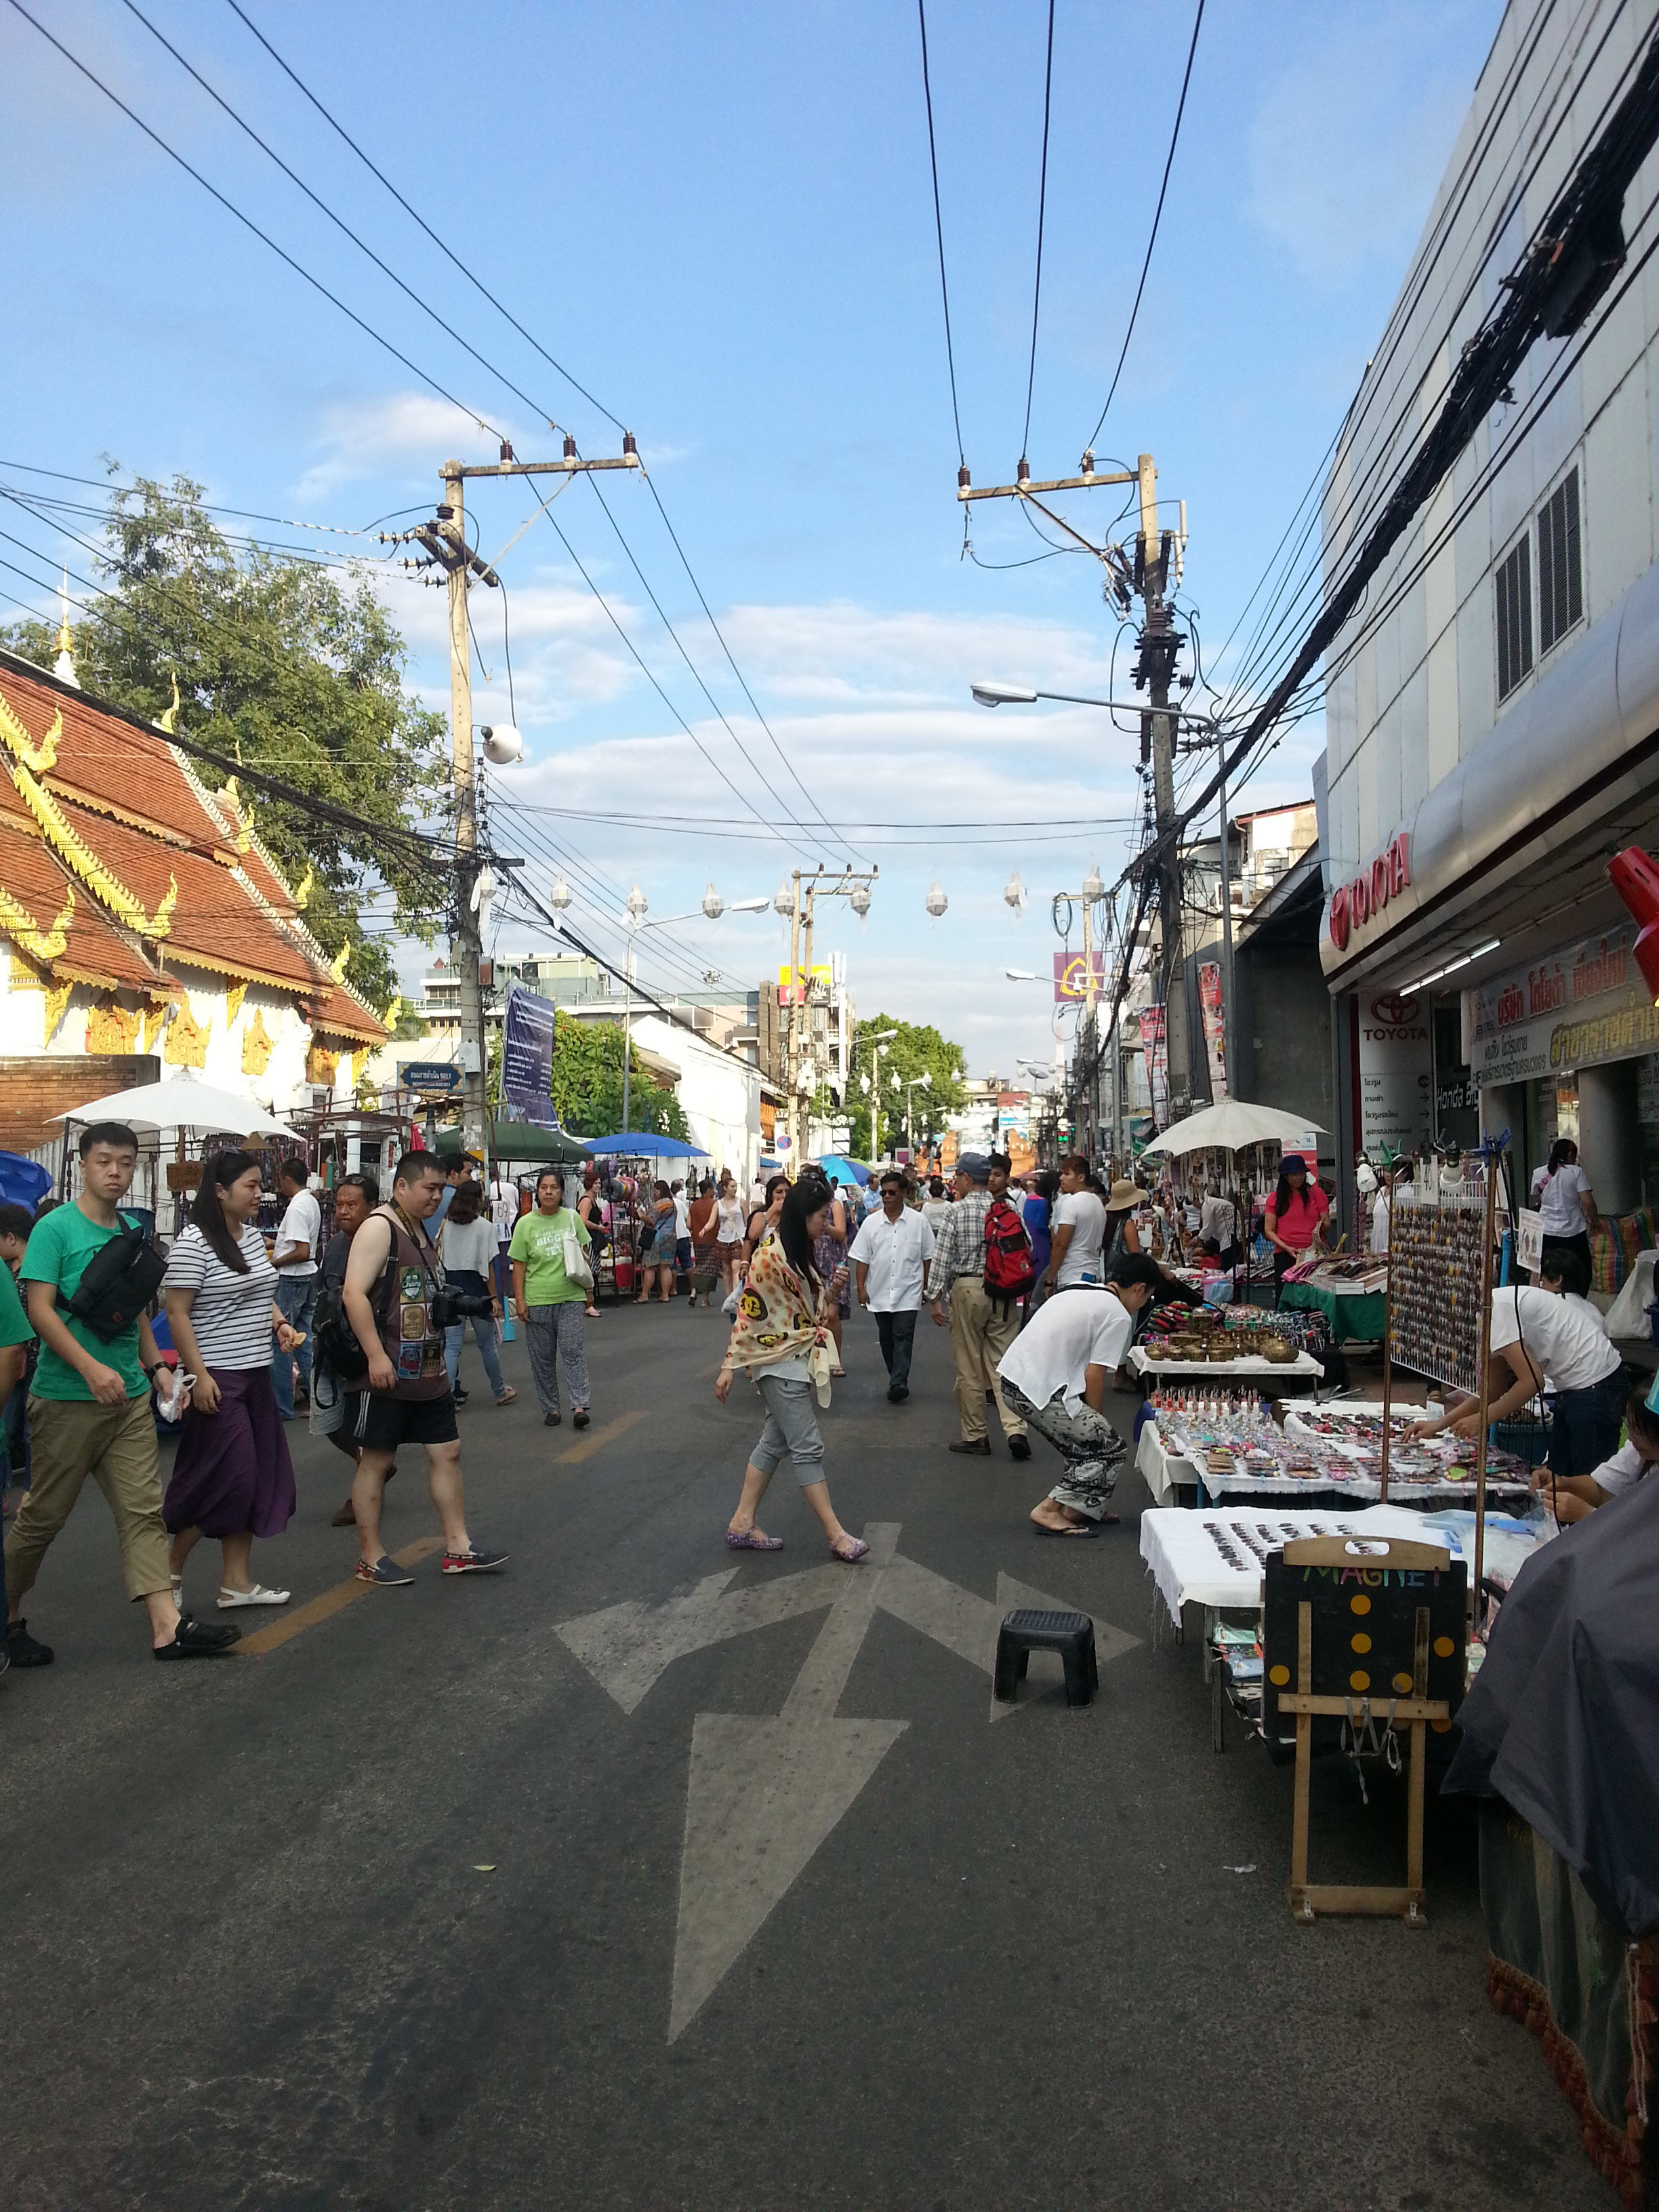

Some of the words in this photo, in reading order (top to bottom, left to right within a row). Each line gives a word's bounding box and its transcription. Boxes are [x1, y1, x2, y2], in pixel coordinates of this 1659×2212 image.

[1351, 833, 1410, 929] TOYOTA
[1363, 1028, 1429, 1041] TOYOTA
[1437, 1083, 1463, 1110] Honda
[1424, 1166, 1432, 1191] 40
[497, 1202, 508, 1218] 69
[537, 1234, 562, 1246] BIGG
[546, 1246, 563, 1256] TEX
